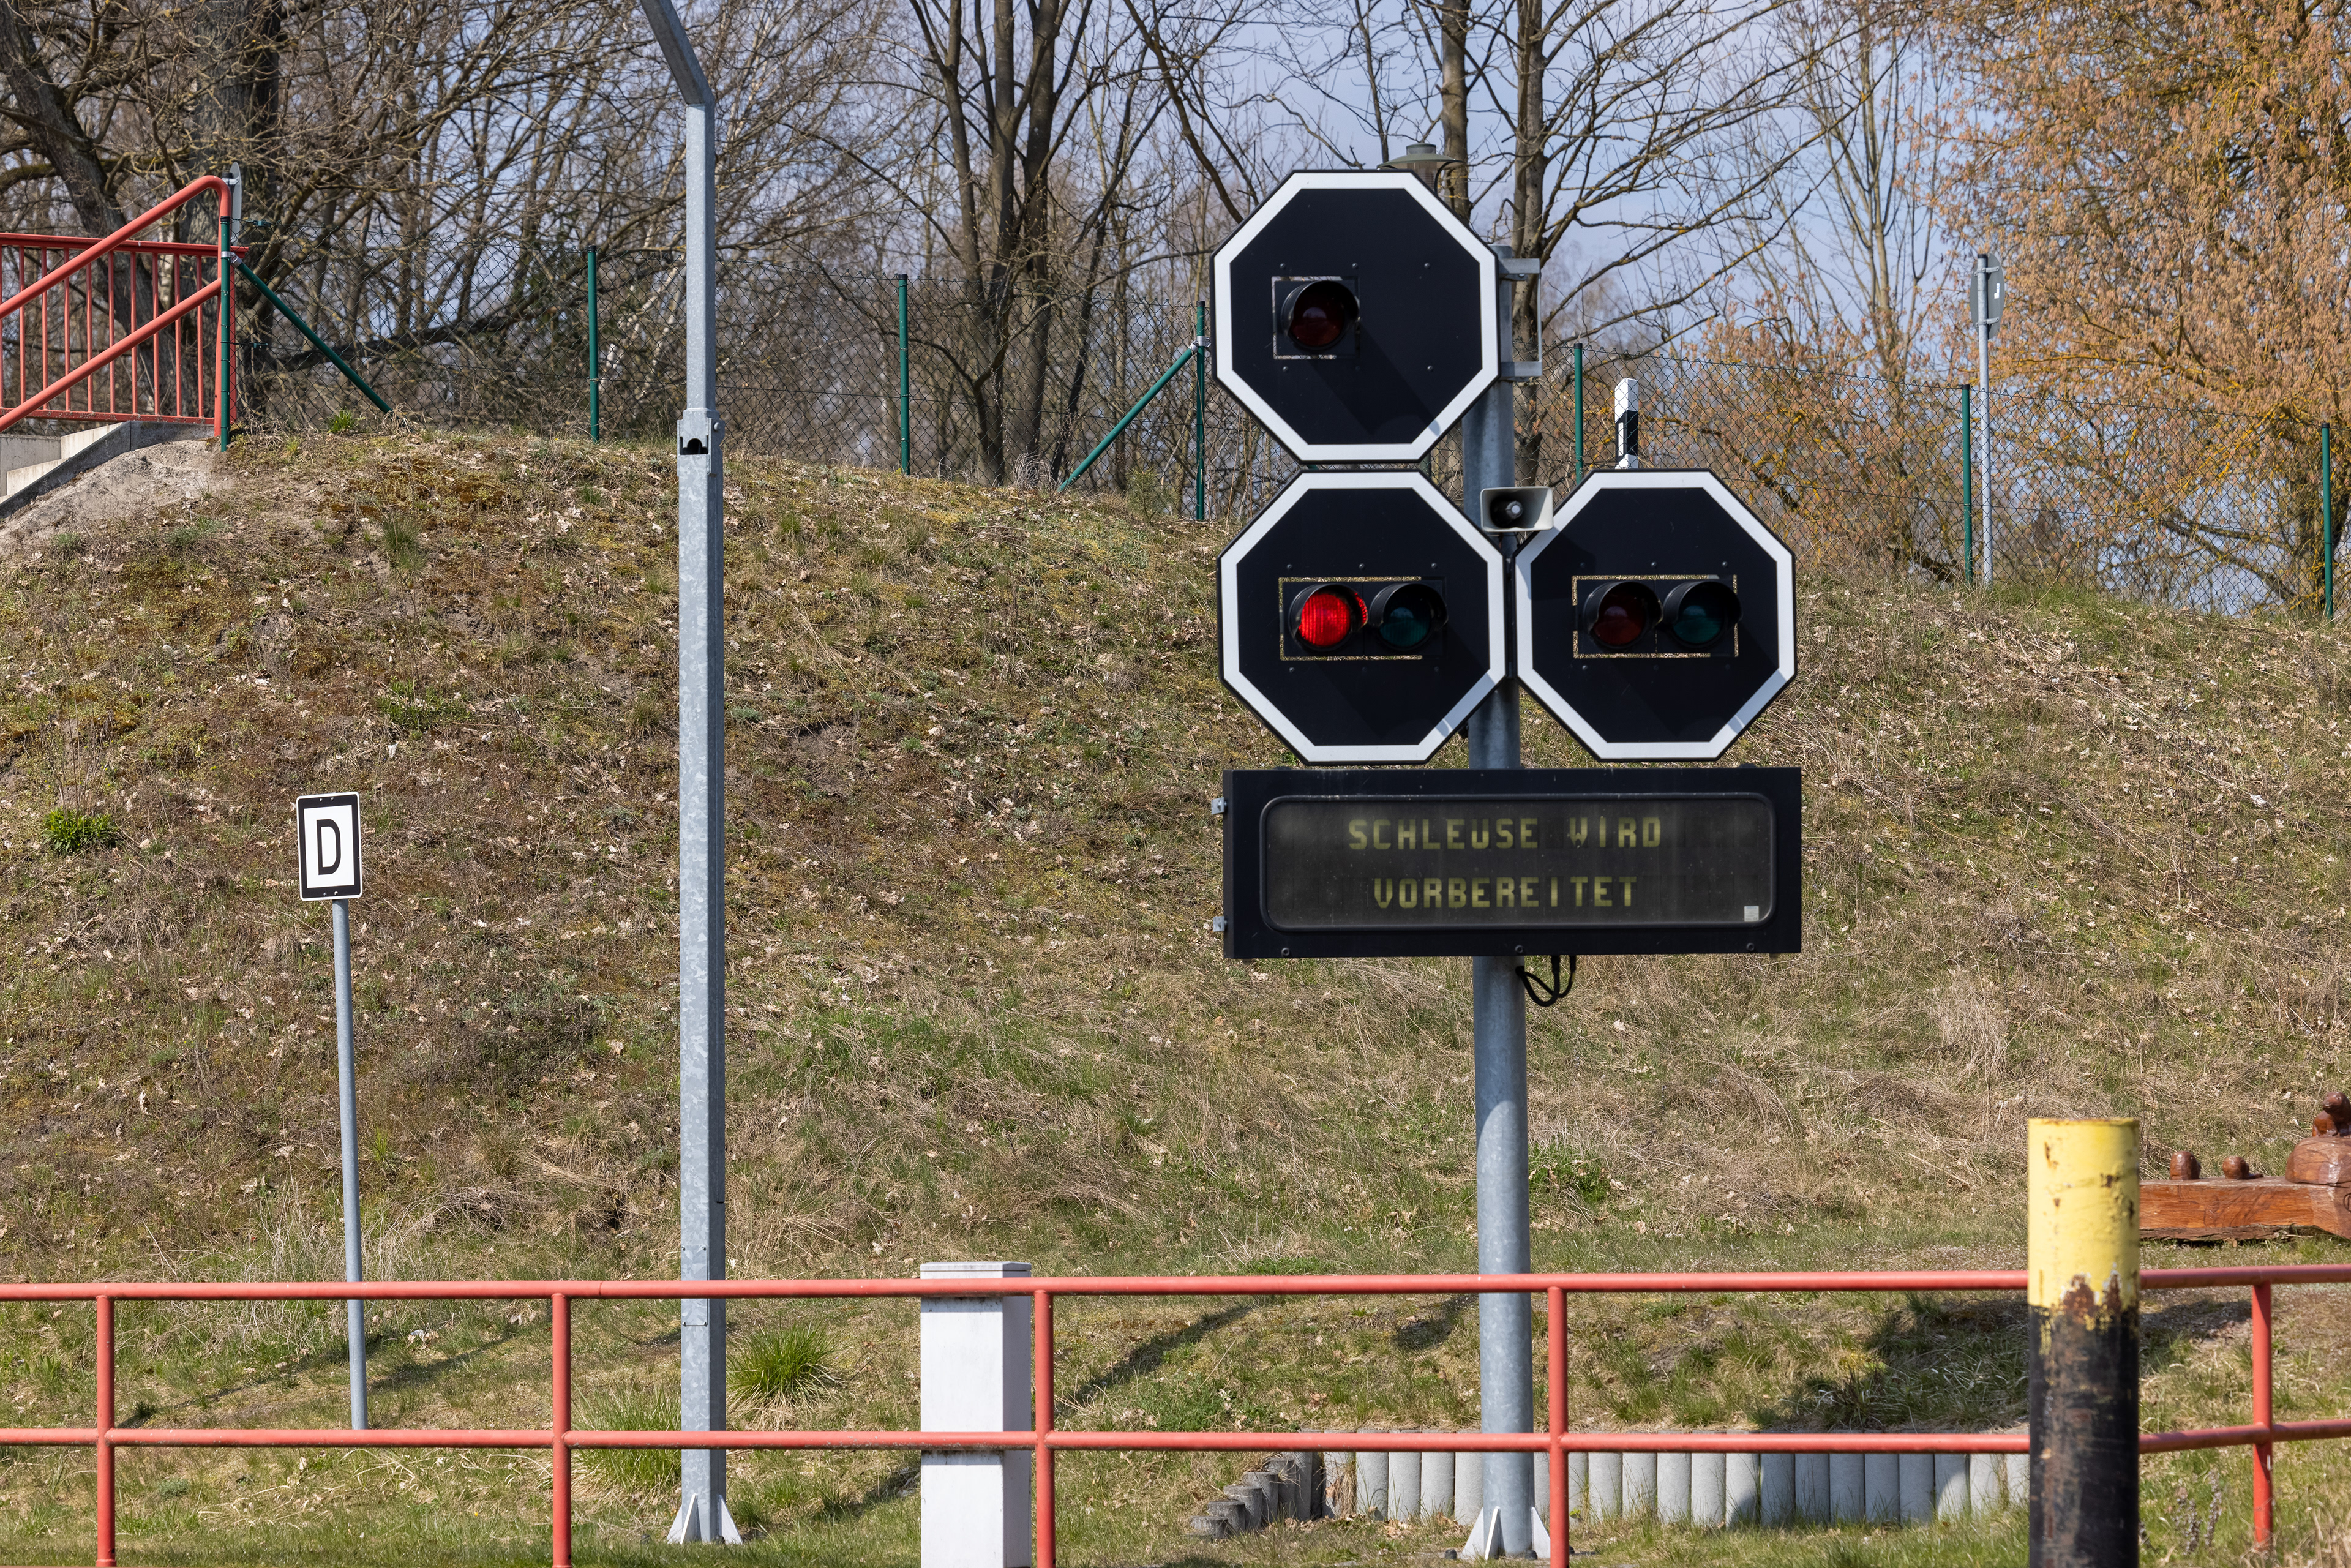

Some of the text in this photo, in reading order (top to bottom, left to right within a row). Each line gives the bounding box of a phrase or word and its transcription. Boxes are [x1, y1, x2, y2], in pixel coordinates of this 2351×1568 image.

[316, 819, 342, 876] D
[1348, 817, 1662, 850] SCHLEUSE WIRD
[1373, 876, 1637, 909] VORBEREITET
